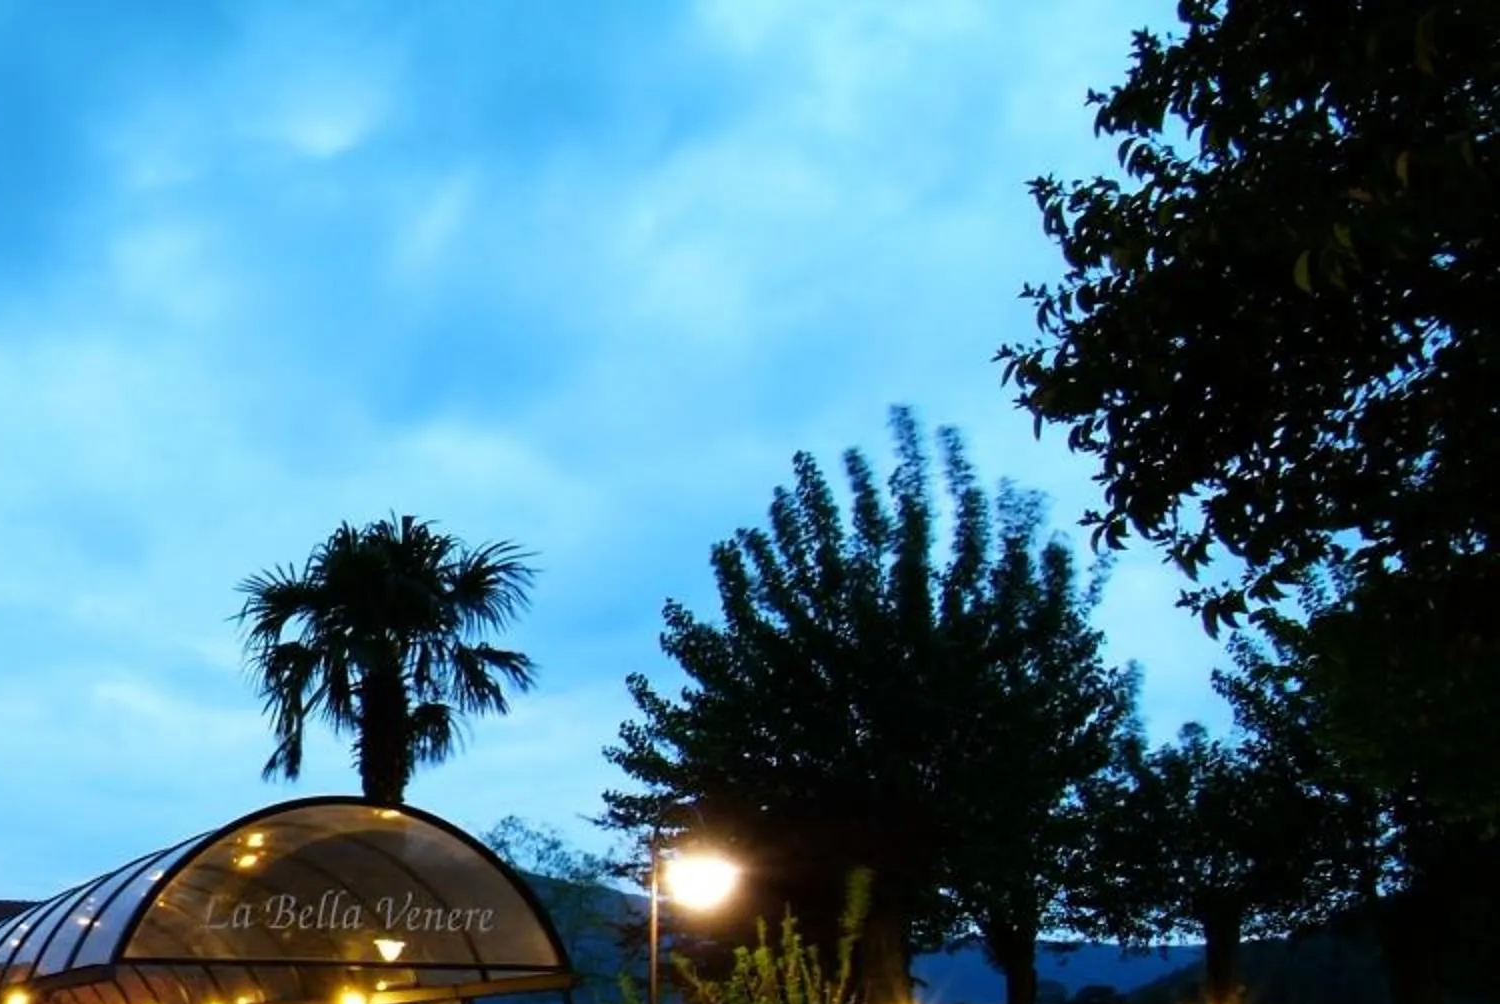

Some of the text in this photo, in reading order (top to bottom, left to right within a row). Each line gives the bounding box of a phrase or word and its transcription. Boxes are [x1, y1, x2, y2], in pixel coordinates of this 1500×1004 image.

[202, 889, 497, 933] La Bella Venere
